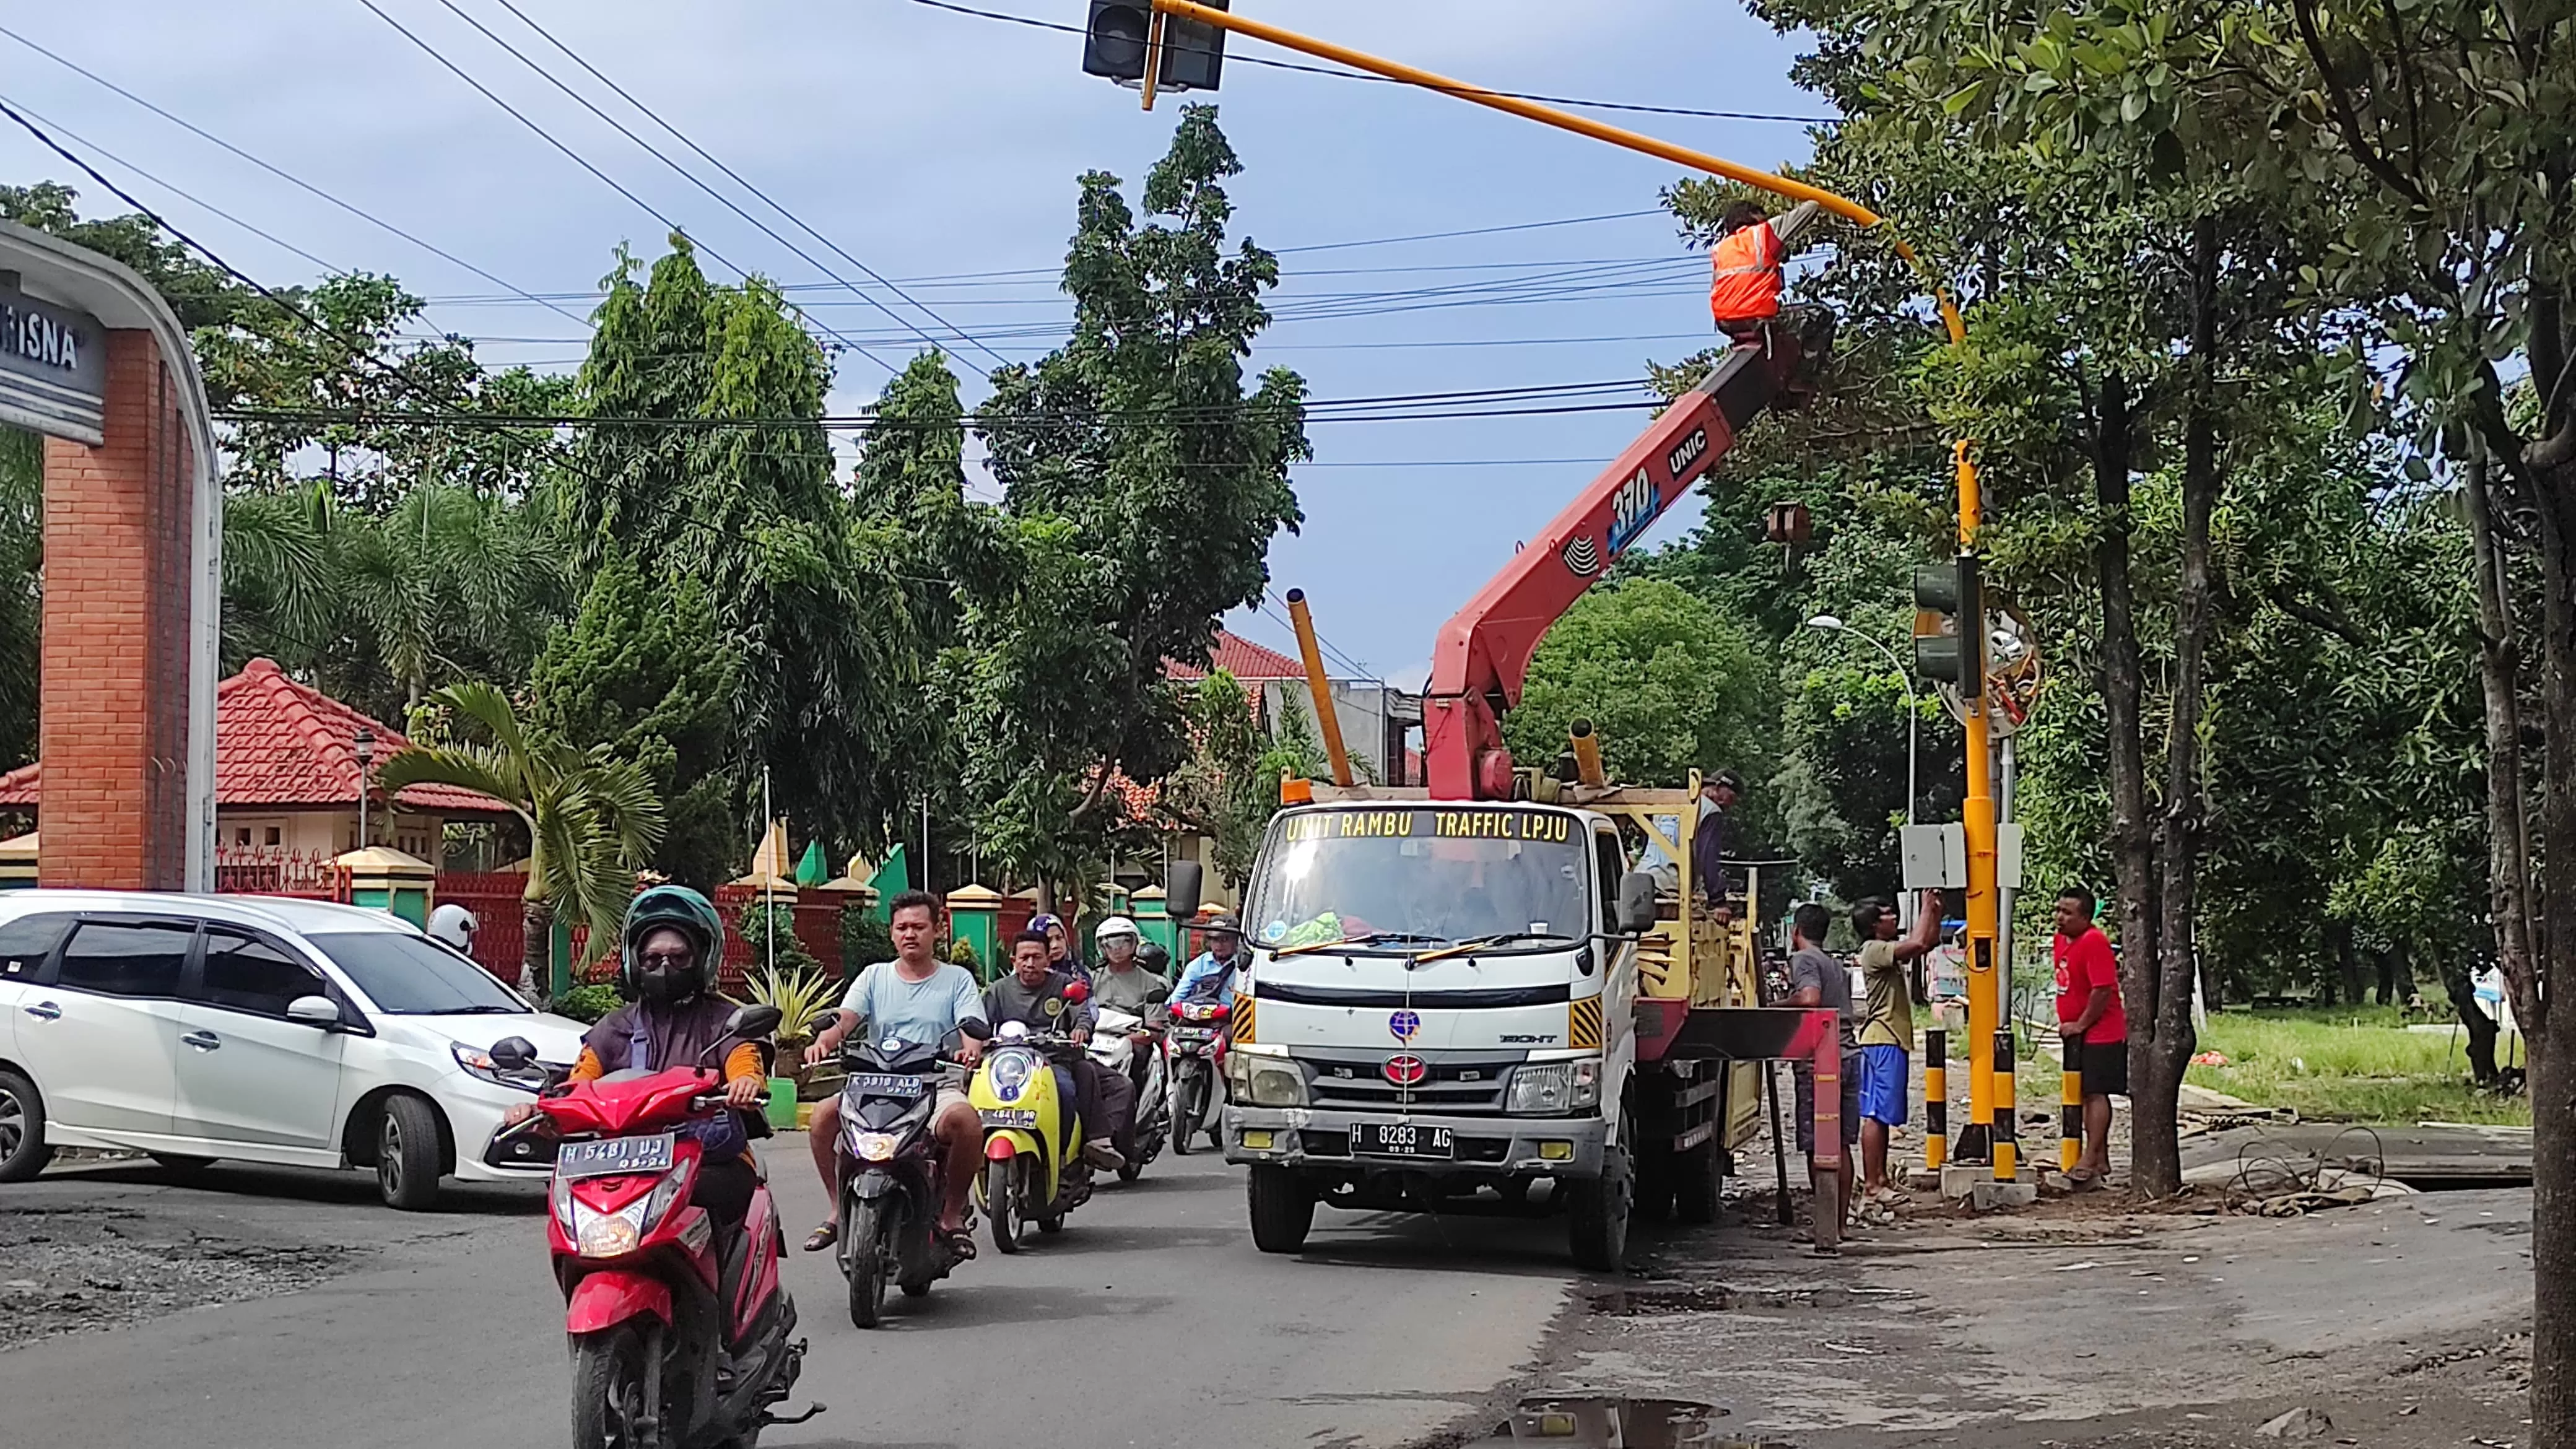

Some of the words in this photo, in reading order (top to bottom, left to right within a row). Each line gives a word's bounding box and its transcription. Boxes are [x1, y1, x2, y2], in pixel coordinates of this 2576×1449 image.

[1669, 430, 1706, 473] UNIC
[1612, 466, 1650, 536] 370
[1287, 815, 1333, 841] UNIT
[1341, 812, 1412, 836] RAMBU
[1435, 812, 1514, 837] TRAFFIC
[1521, 814, 1568, 841] LPJU
[1352, 1124, 1362, 1143] H
[1379, 1126, 1416, 1144] 8283
[1433, 1128, 1451, 1147] AG
[565, 1146, 578, 1163] H
[639, 1139, 663, 1155] UJ
